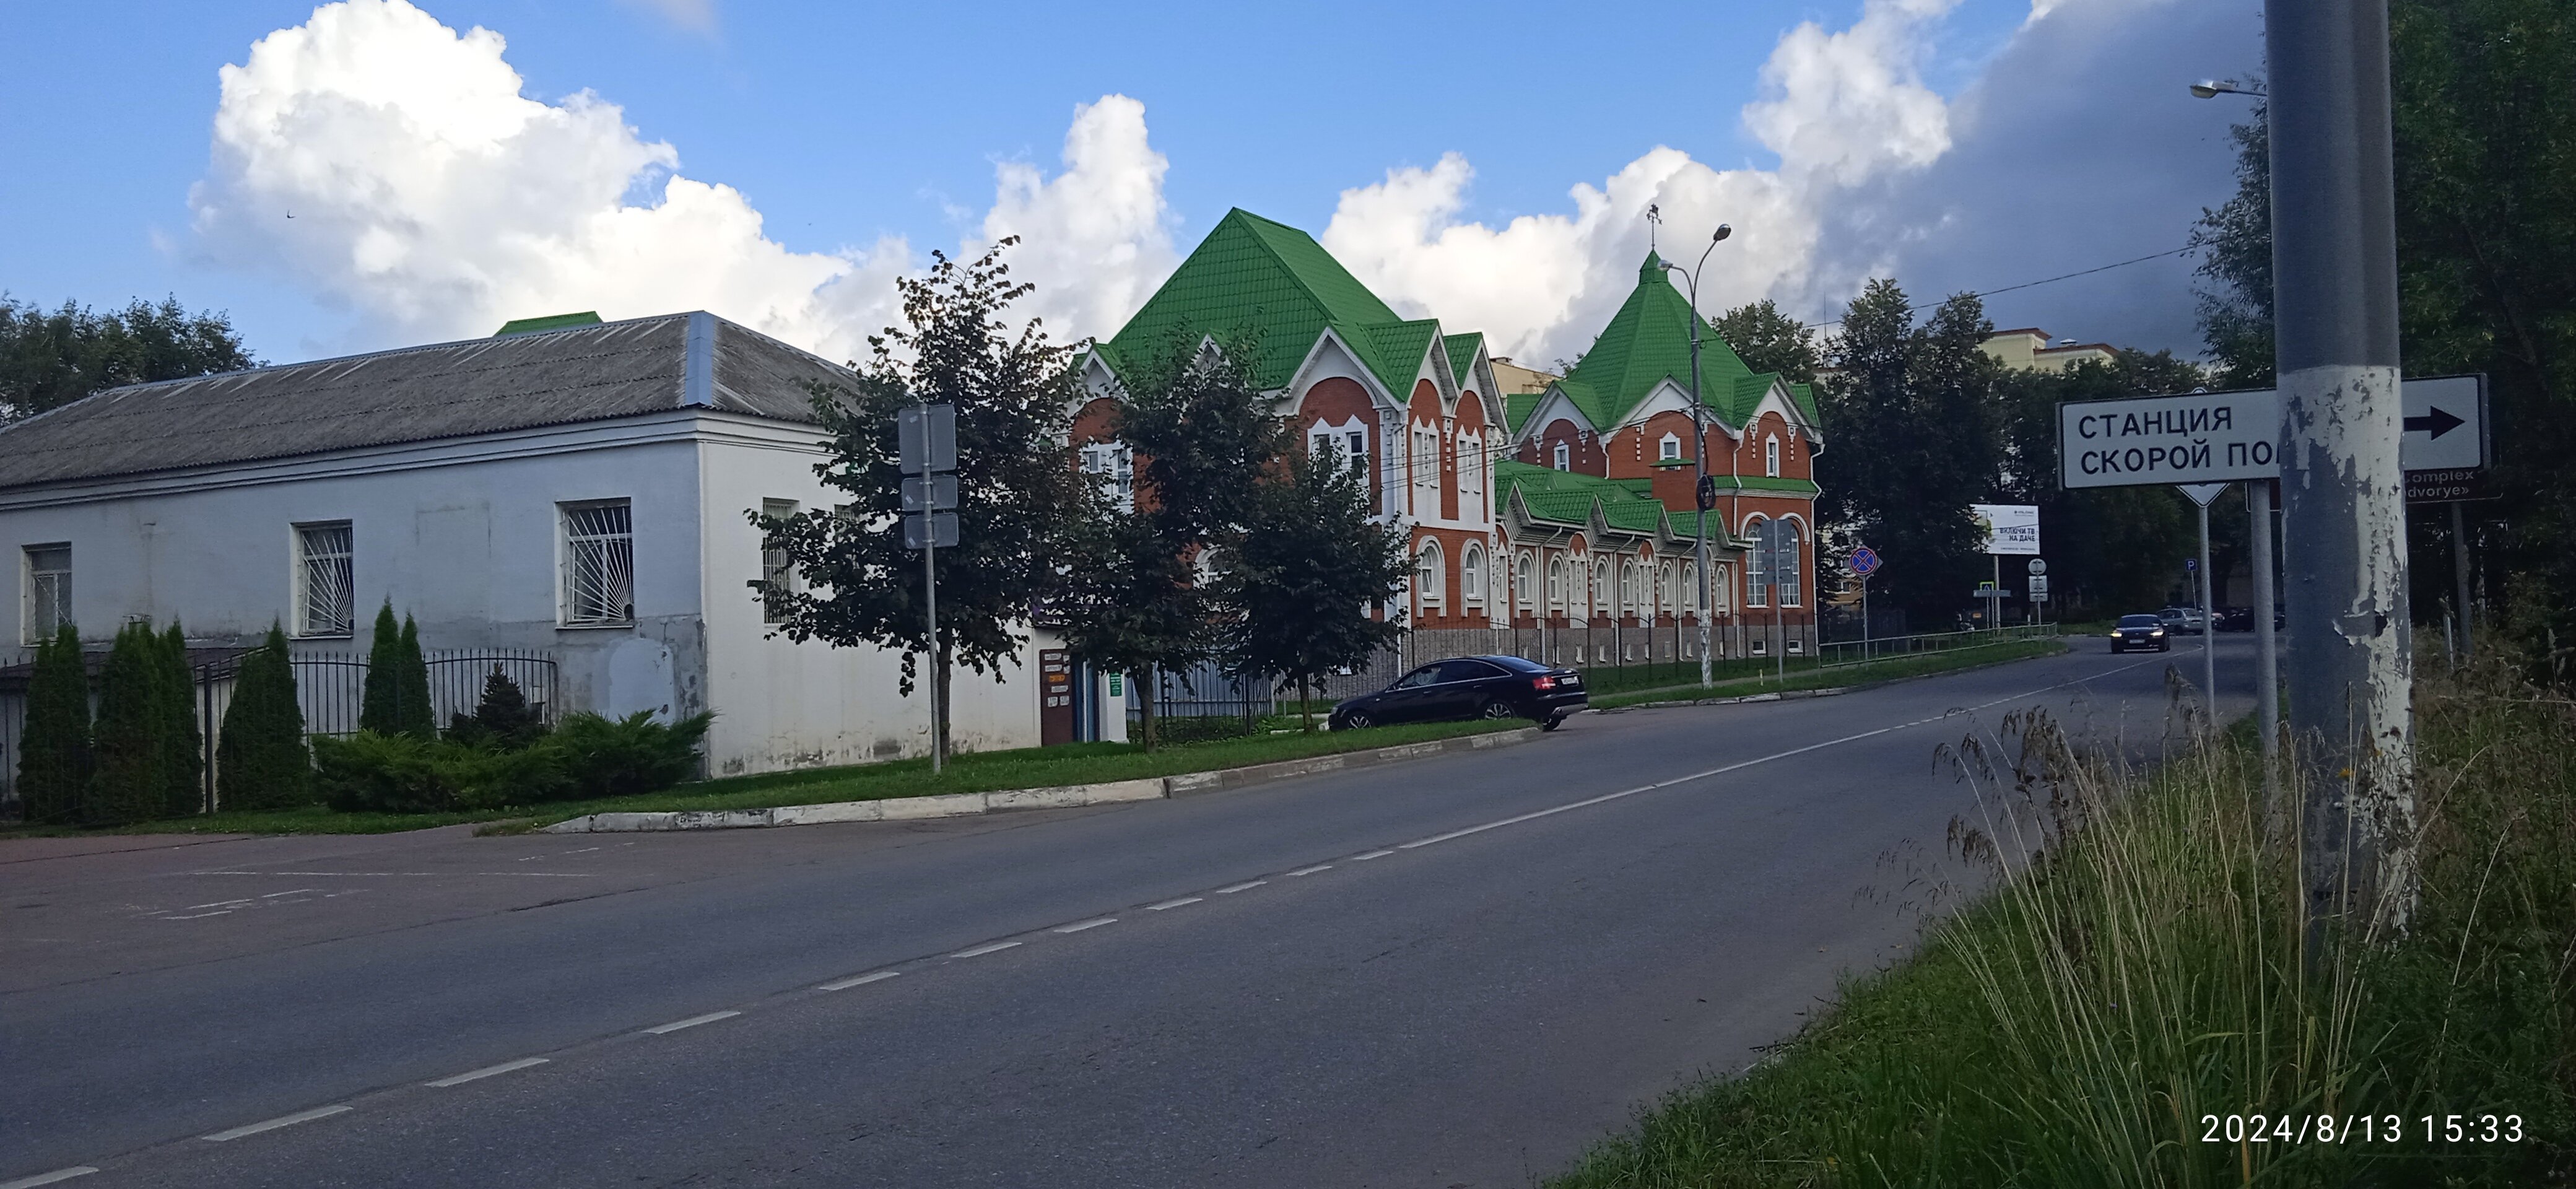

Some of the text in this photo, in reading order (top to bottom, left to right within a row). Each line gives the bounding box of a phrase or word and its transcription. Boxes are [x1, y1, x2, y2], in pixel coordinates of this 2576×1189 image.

[2078, 406, 2231, 439] СТАНЦИЯ
[2081, 438, 2280, 474] СКОРОЙ ПО
[2406, 486, 2469, 499] dvorye»
[2187, 560, 2195, 570] P
